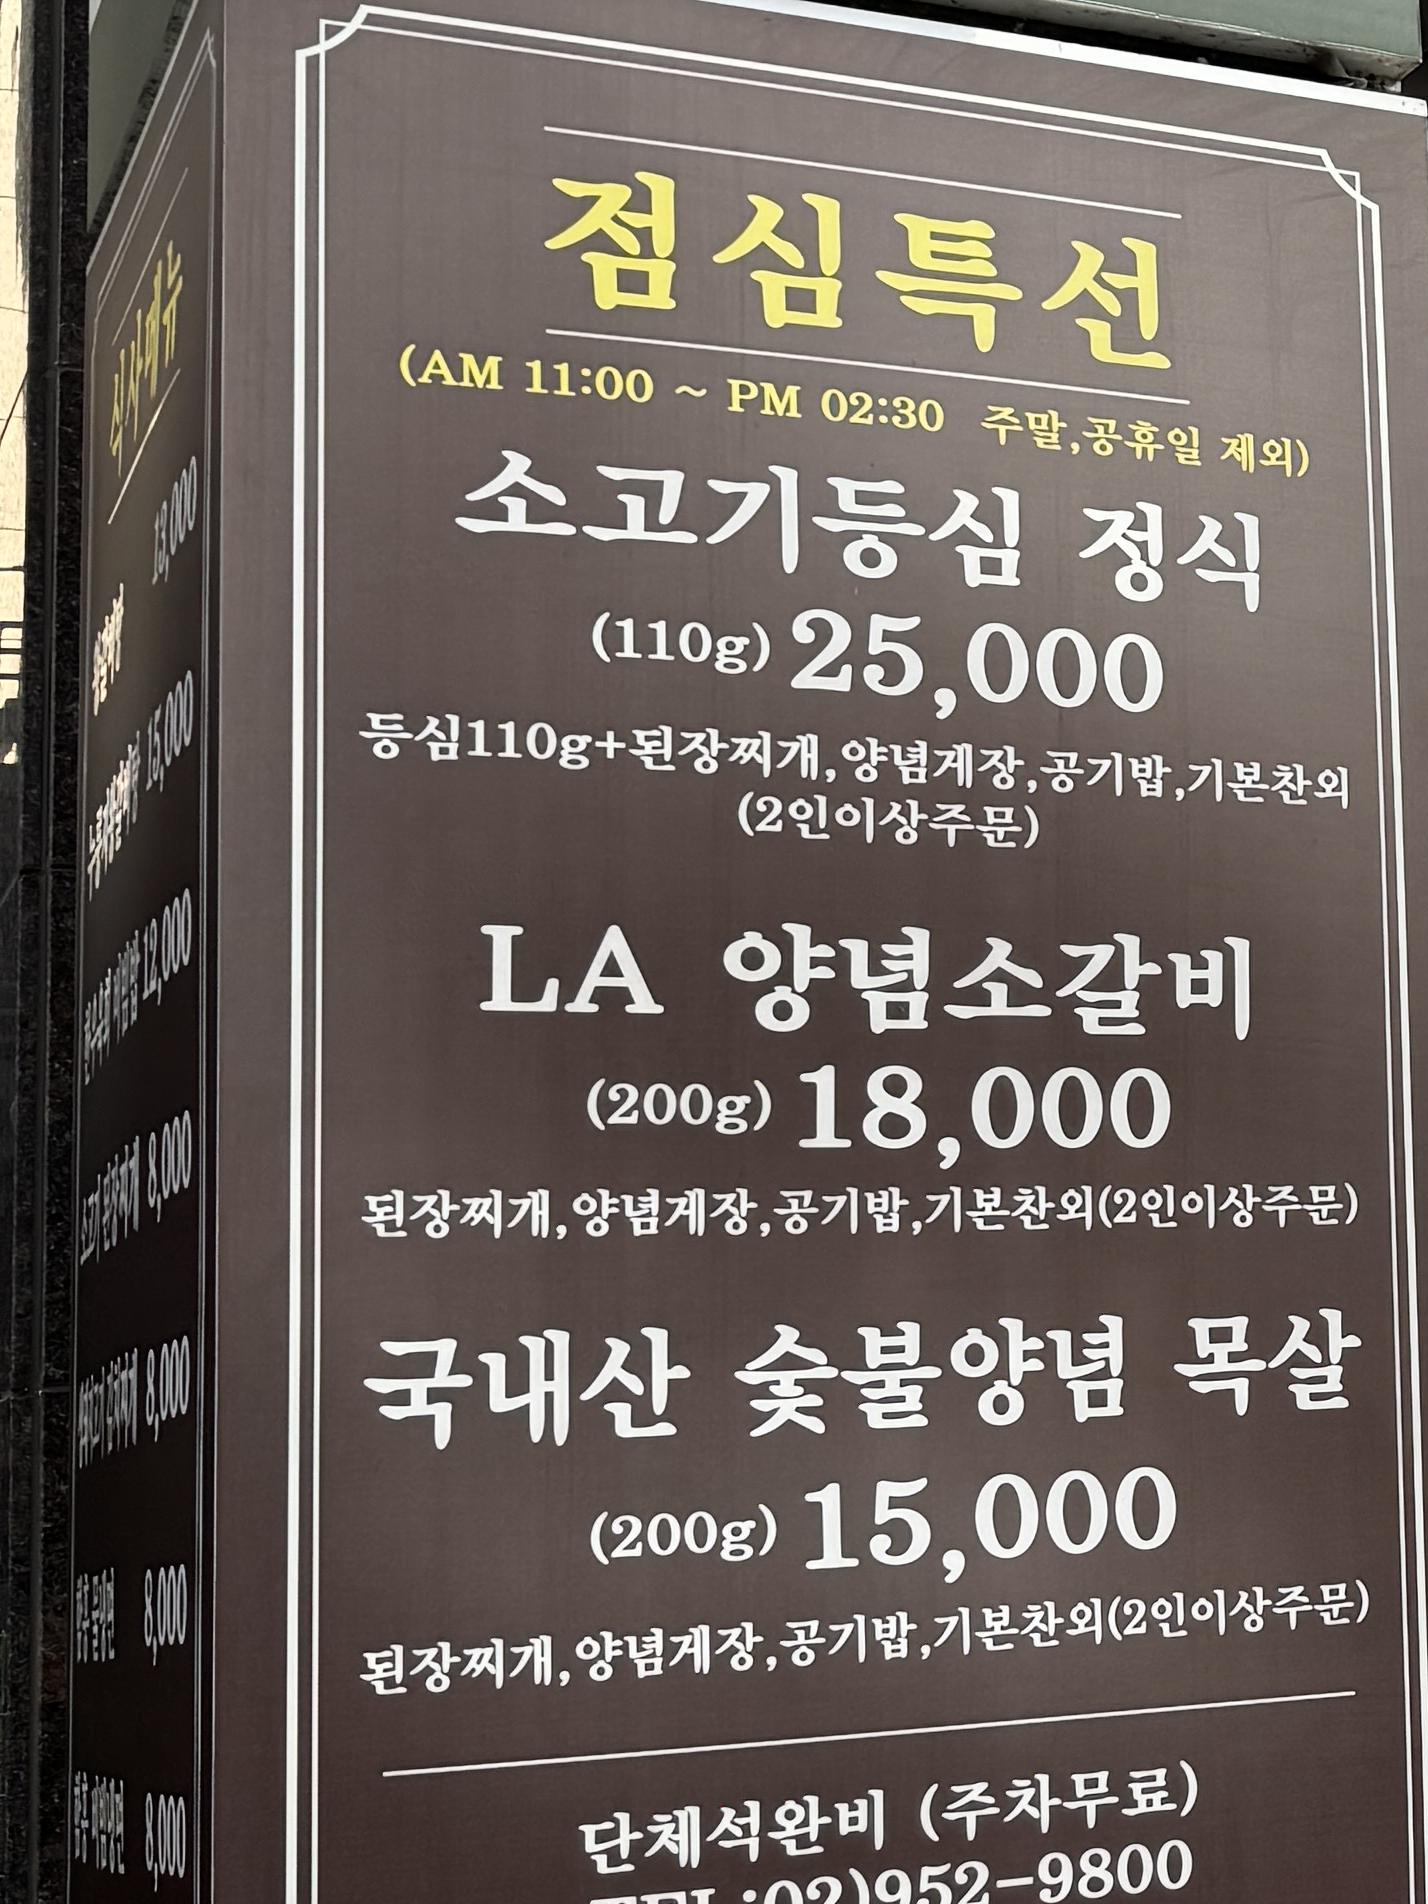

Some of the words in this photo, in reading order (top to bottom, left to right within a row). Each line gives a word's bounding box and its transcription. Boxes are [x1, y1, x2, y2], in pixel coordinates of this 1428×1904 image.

[543, 172, 1172, 370] 점심특선
[109, 240, 183, 478] 식사메뉴
[399, 345, 503, 392] (AM
[524, 362, 654, 405] 11:00
[727, 378, 802, 419] PM
[821, 387, 944, 433] 02:30
[981, 405, 1203, 467] 주말,공휴일
[1220, 433, 1311, 479] 제외)
[151, 454, 198, 586] 13,000
[454, 449, 1022, 589] 소고기등심
[1079, 500, 1261, 614] 정식
[592, 611, 770, 675] (110g)
[789, 609, 1164, 720] 25,000
[145, 668, 194, 793] 15,000
[737, 793, 1040, 849] (2인이상주문)
[142, 887, 192, 1007] 12,000
[479, 924, 665, 1014] LA
[722, 921, 1253, 1042] 양념소갈비
[147, 1108, 192, 1224] 8,000
[586, 1077, 773, 1135] (200g)
[799, 1063, 1172, 1170] 18,000
[145, 1334, 190, 1443] 8,000
[364, 1325, 691, 1450] 국내산
[734, 1313, 1126, 1439] 숯불양념
[1172, 1307, 1362, 1418] 목살
[589, 1506, 778, 1565] (200g)
[803, 1465, 1178, 1584] 15,000
[144, 1562, 188, 1667] 8,000
[145, 1789, 187, 1894] 8,000
[580, 1787, 886, 1877] 단체석완비
[919, 1759, 1199, 1843] (주차무료)
